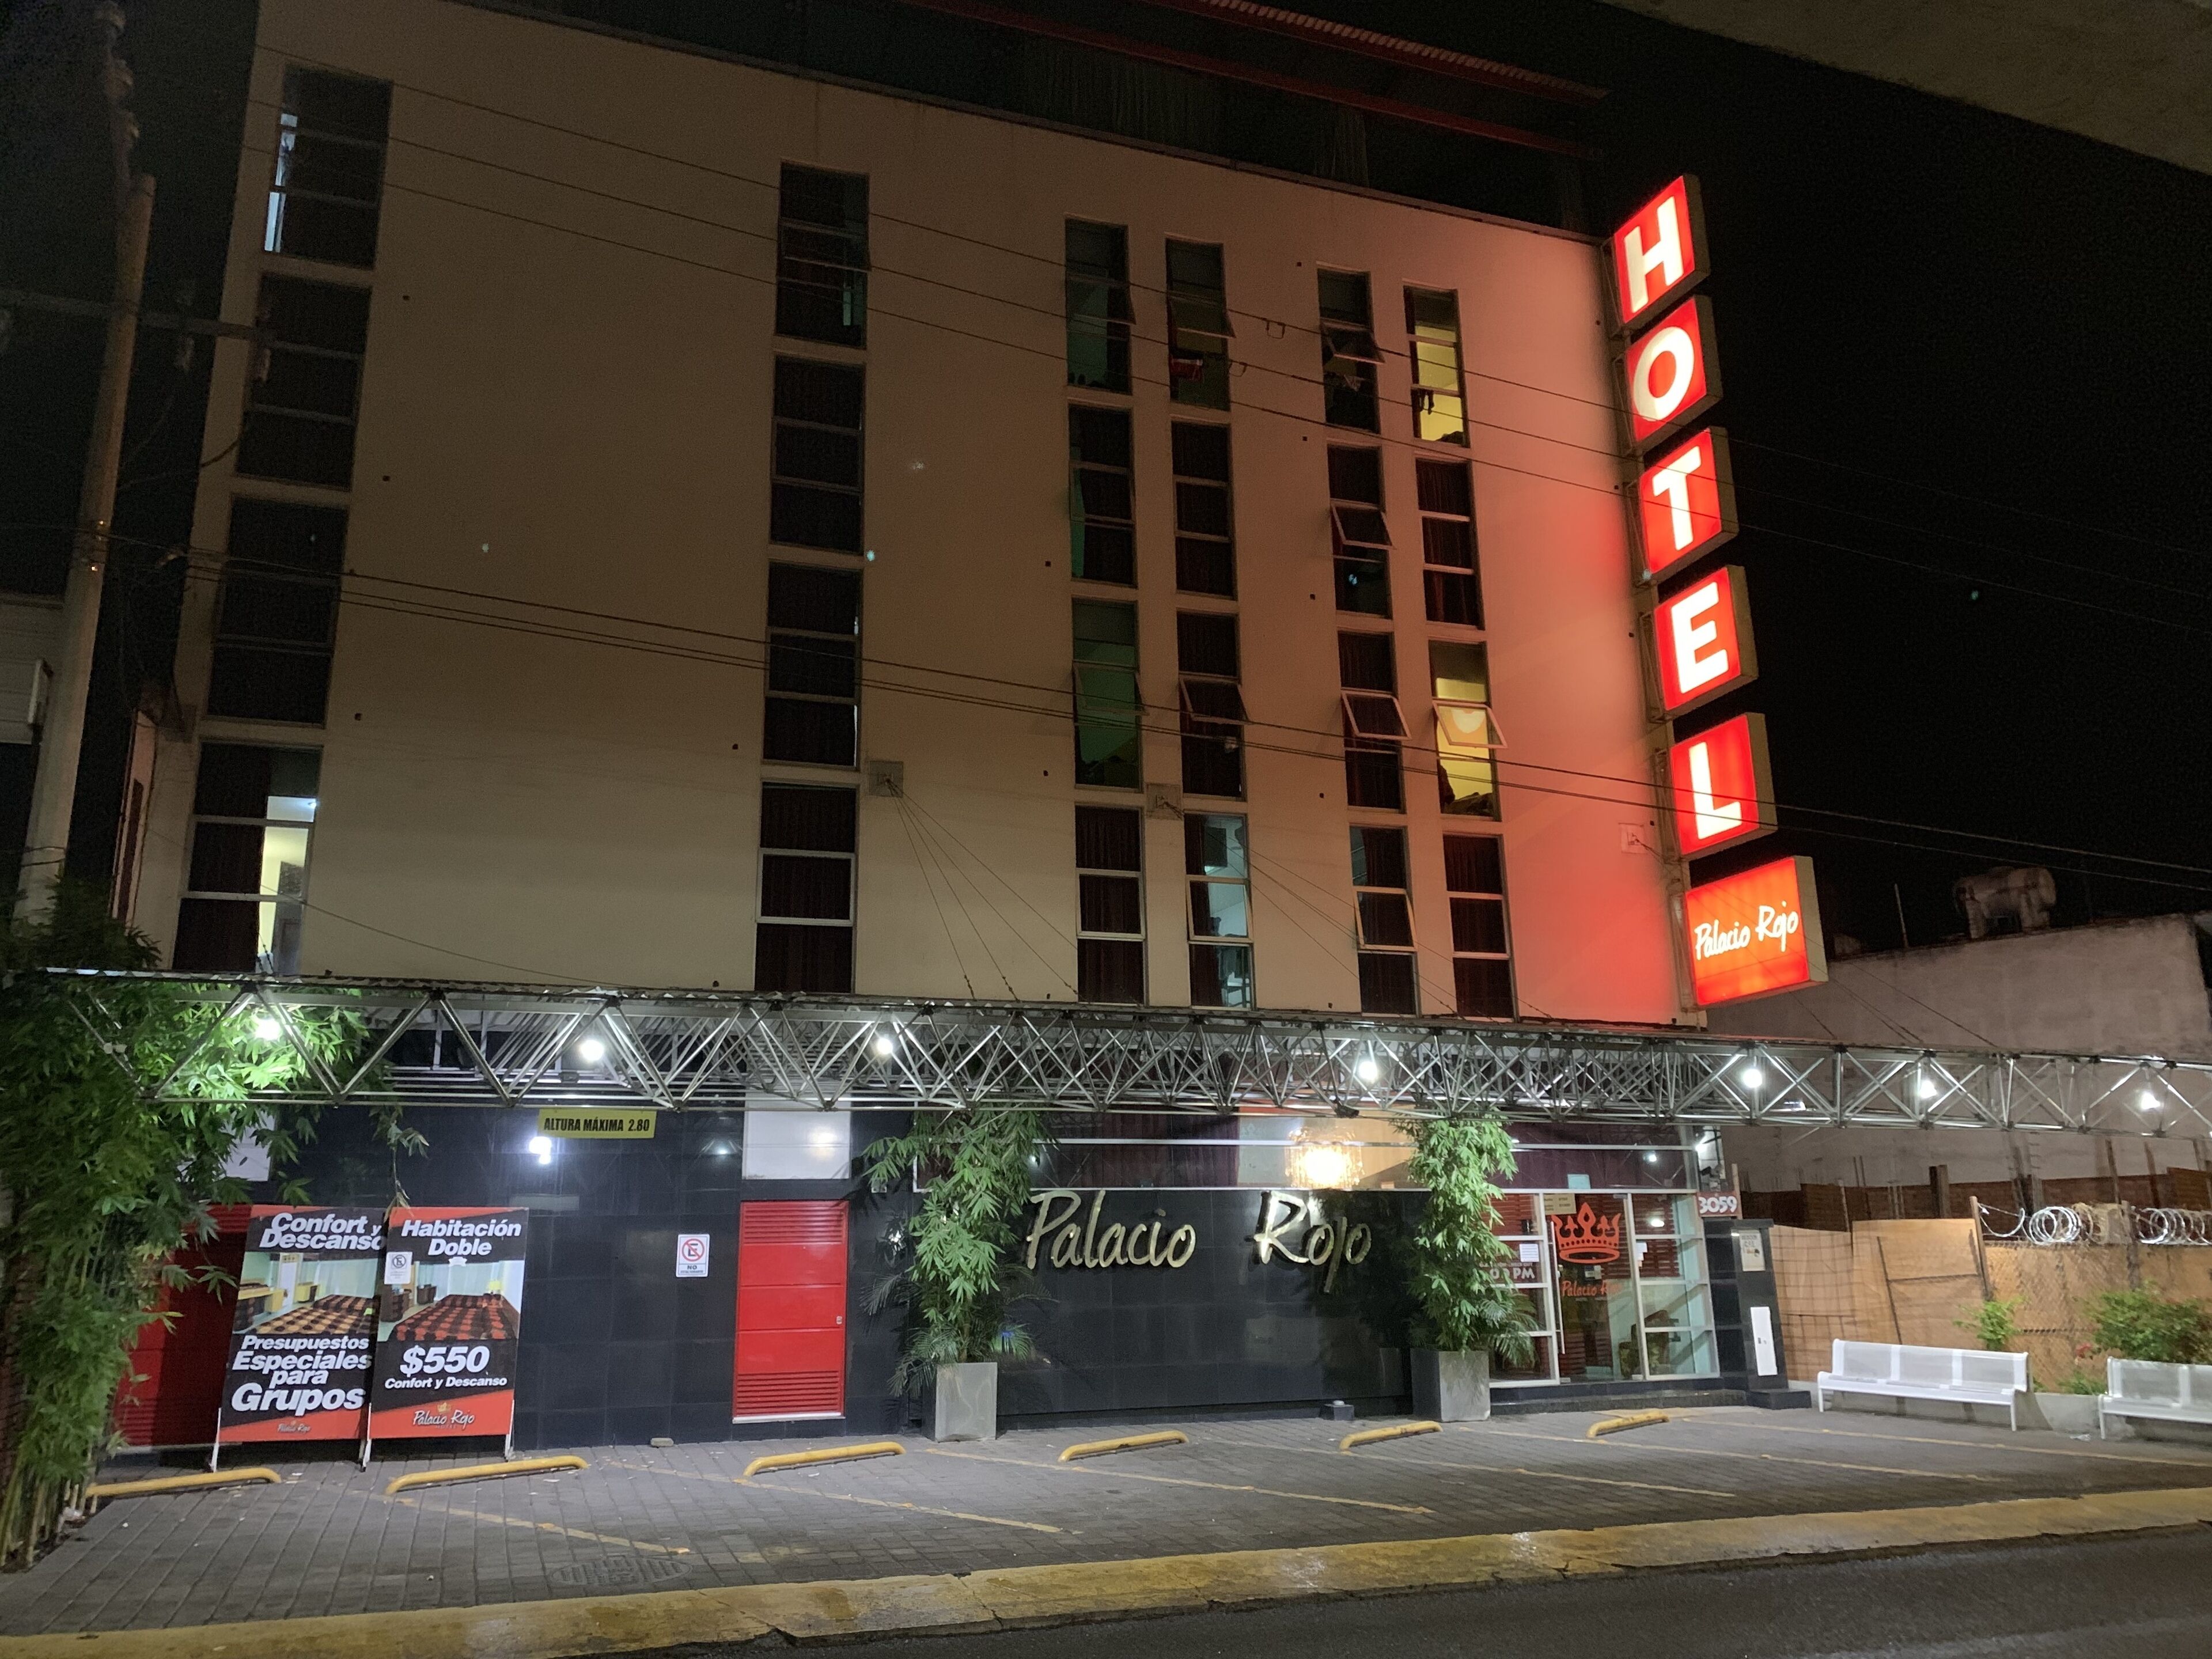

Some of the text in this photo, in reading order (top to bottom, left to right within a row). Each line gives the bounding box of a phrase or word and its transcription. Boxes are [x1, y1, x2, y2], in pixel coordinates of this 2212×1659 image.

[1623, 196, 1743, 841] HOTEL
[1694, 900, 1799, 960] Palacio Rojo
[544, 1116, 650, 1132] ALTURA MÁXIMA 2.80
[1698, 1195, 1737, 1214] 3059
[271, 1212, 382, 1236] Confort y
[401, 1218, 522, 1237] Habitación
[259, 1228, 387, 1251] Descanso
[427, 1238, 493, 1256] Doble
[1027, 1189, 1372, 1293] Palacio Rojo
[1513, 1267, 1535, 1279] PM
[1562, 1281, 1598, 1297] Palacio
[241, 1335, 369, 1353] Presupuestos
[232, 1350, 373, 1374] Especiales
[400, 1344, 490, 1378] $550
[269, 1369, 329, 1389] para
[385, 1376, 508, 1389] Confort y Descanso
[231, 1382, 366, 1416] Grupos
[413, 1409, 475, 1430] Palacio Rojo
